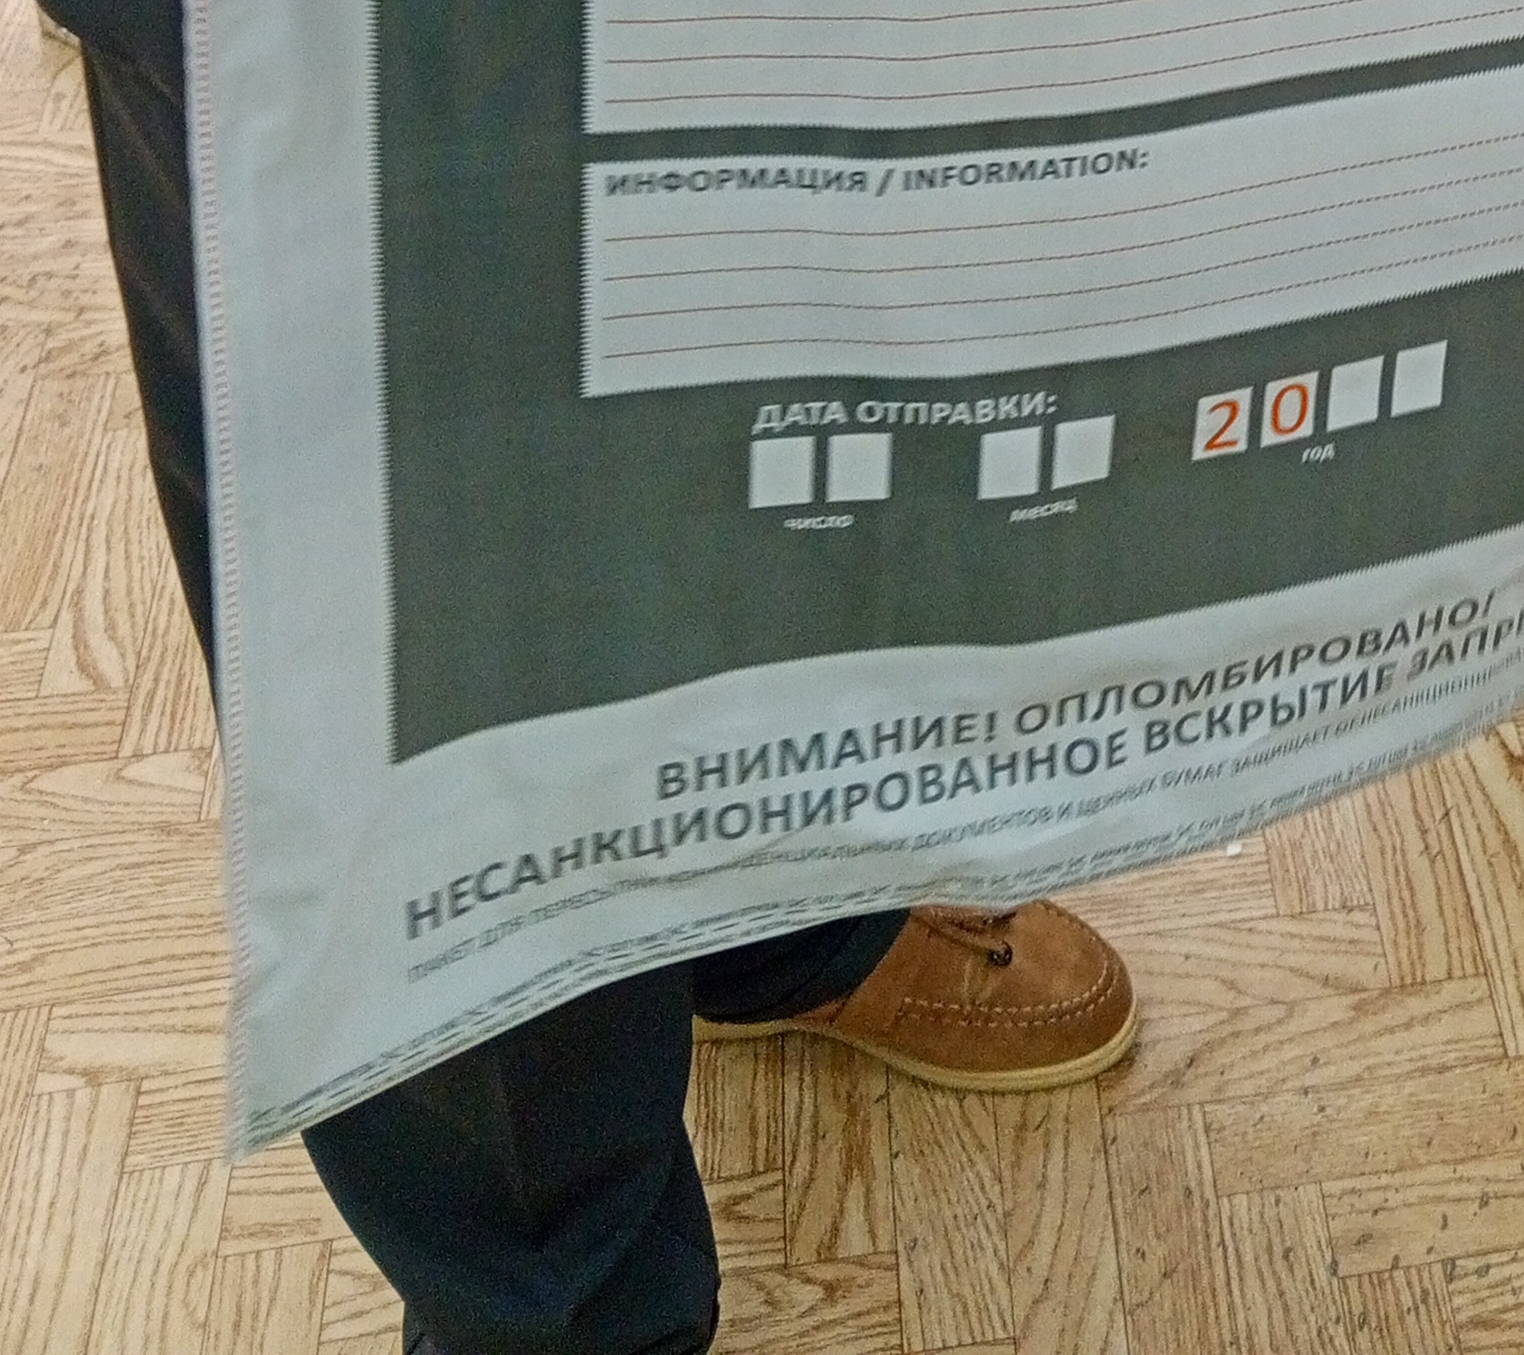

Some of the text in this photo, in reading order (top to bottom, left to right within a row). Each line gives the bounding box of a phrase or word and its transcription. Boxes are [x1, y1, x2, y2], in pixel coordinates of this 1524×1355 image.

[603, 165, 869, 198] ИНФОРМАЦИЯ
[902, 145, 1150, 192] INFORMATION:
[751, 391, 1058, 435] ДАТА ОТПРАВКИ:
[1009, 496, 1078, 523] месяц
[656, 587, 1501, 802] ВНИМАНИЕ! ОПЛОМБИРОВАНО!
[404, 727, 1130, 941] НЕСАНКЦИОНИРОВАННОЕ
[1143, 658, 1399, 757] ВСКРЫТИЕ
